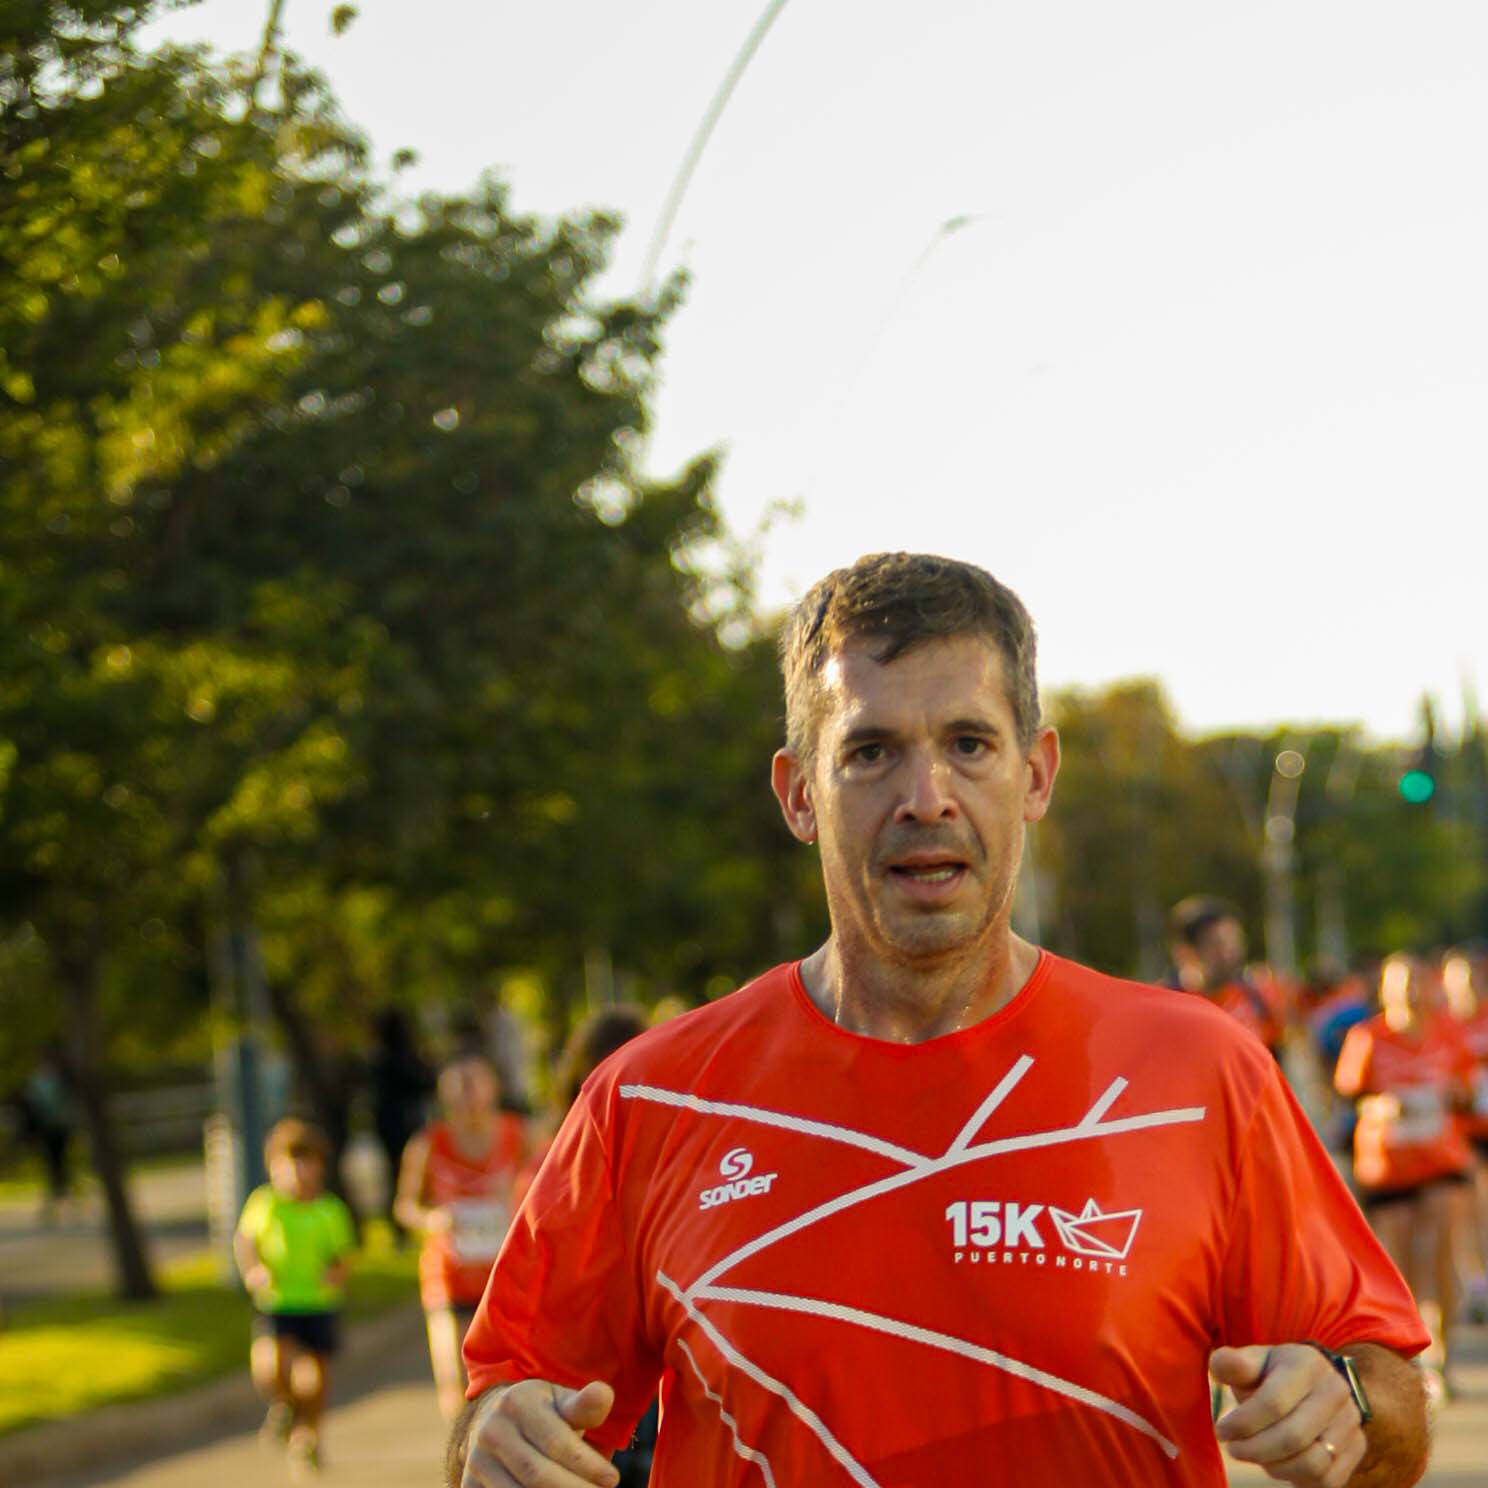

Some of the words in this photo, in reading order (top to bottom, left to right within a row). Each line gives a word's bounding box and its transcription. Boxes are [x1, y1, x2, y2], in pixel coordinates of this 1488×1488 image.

[945, 1201, 1045, 1247] 15K
[954, 1252, 1046, 1265] PUERTO
[1056, 1256, 1127, 1276] NORTE
